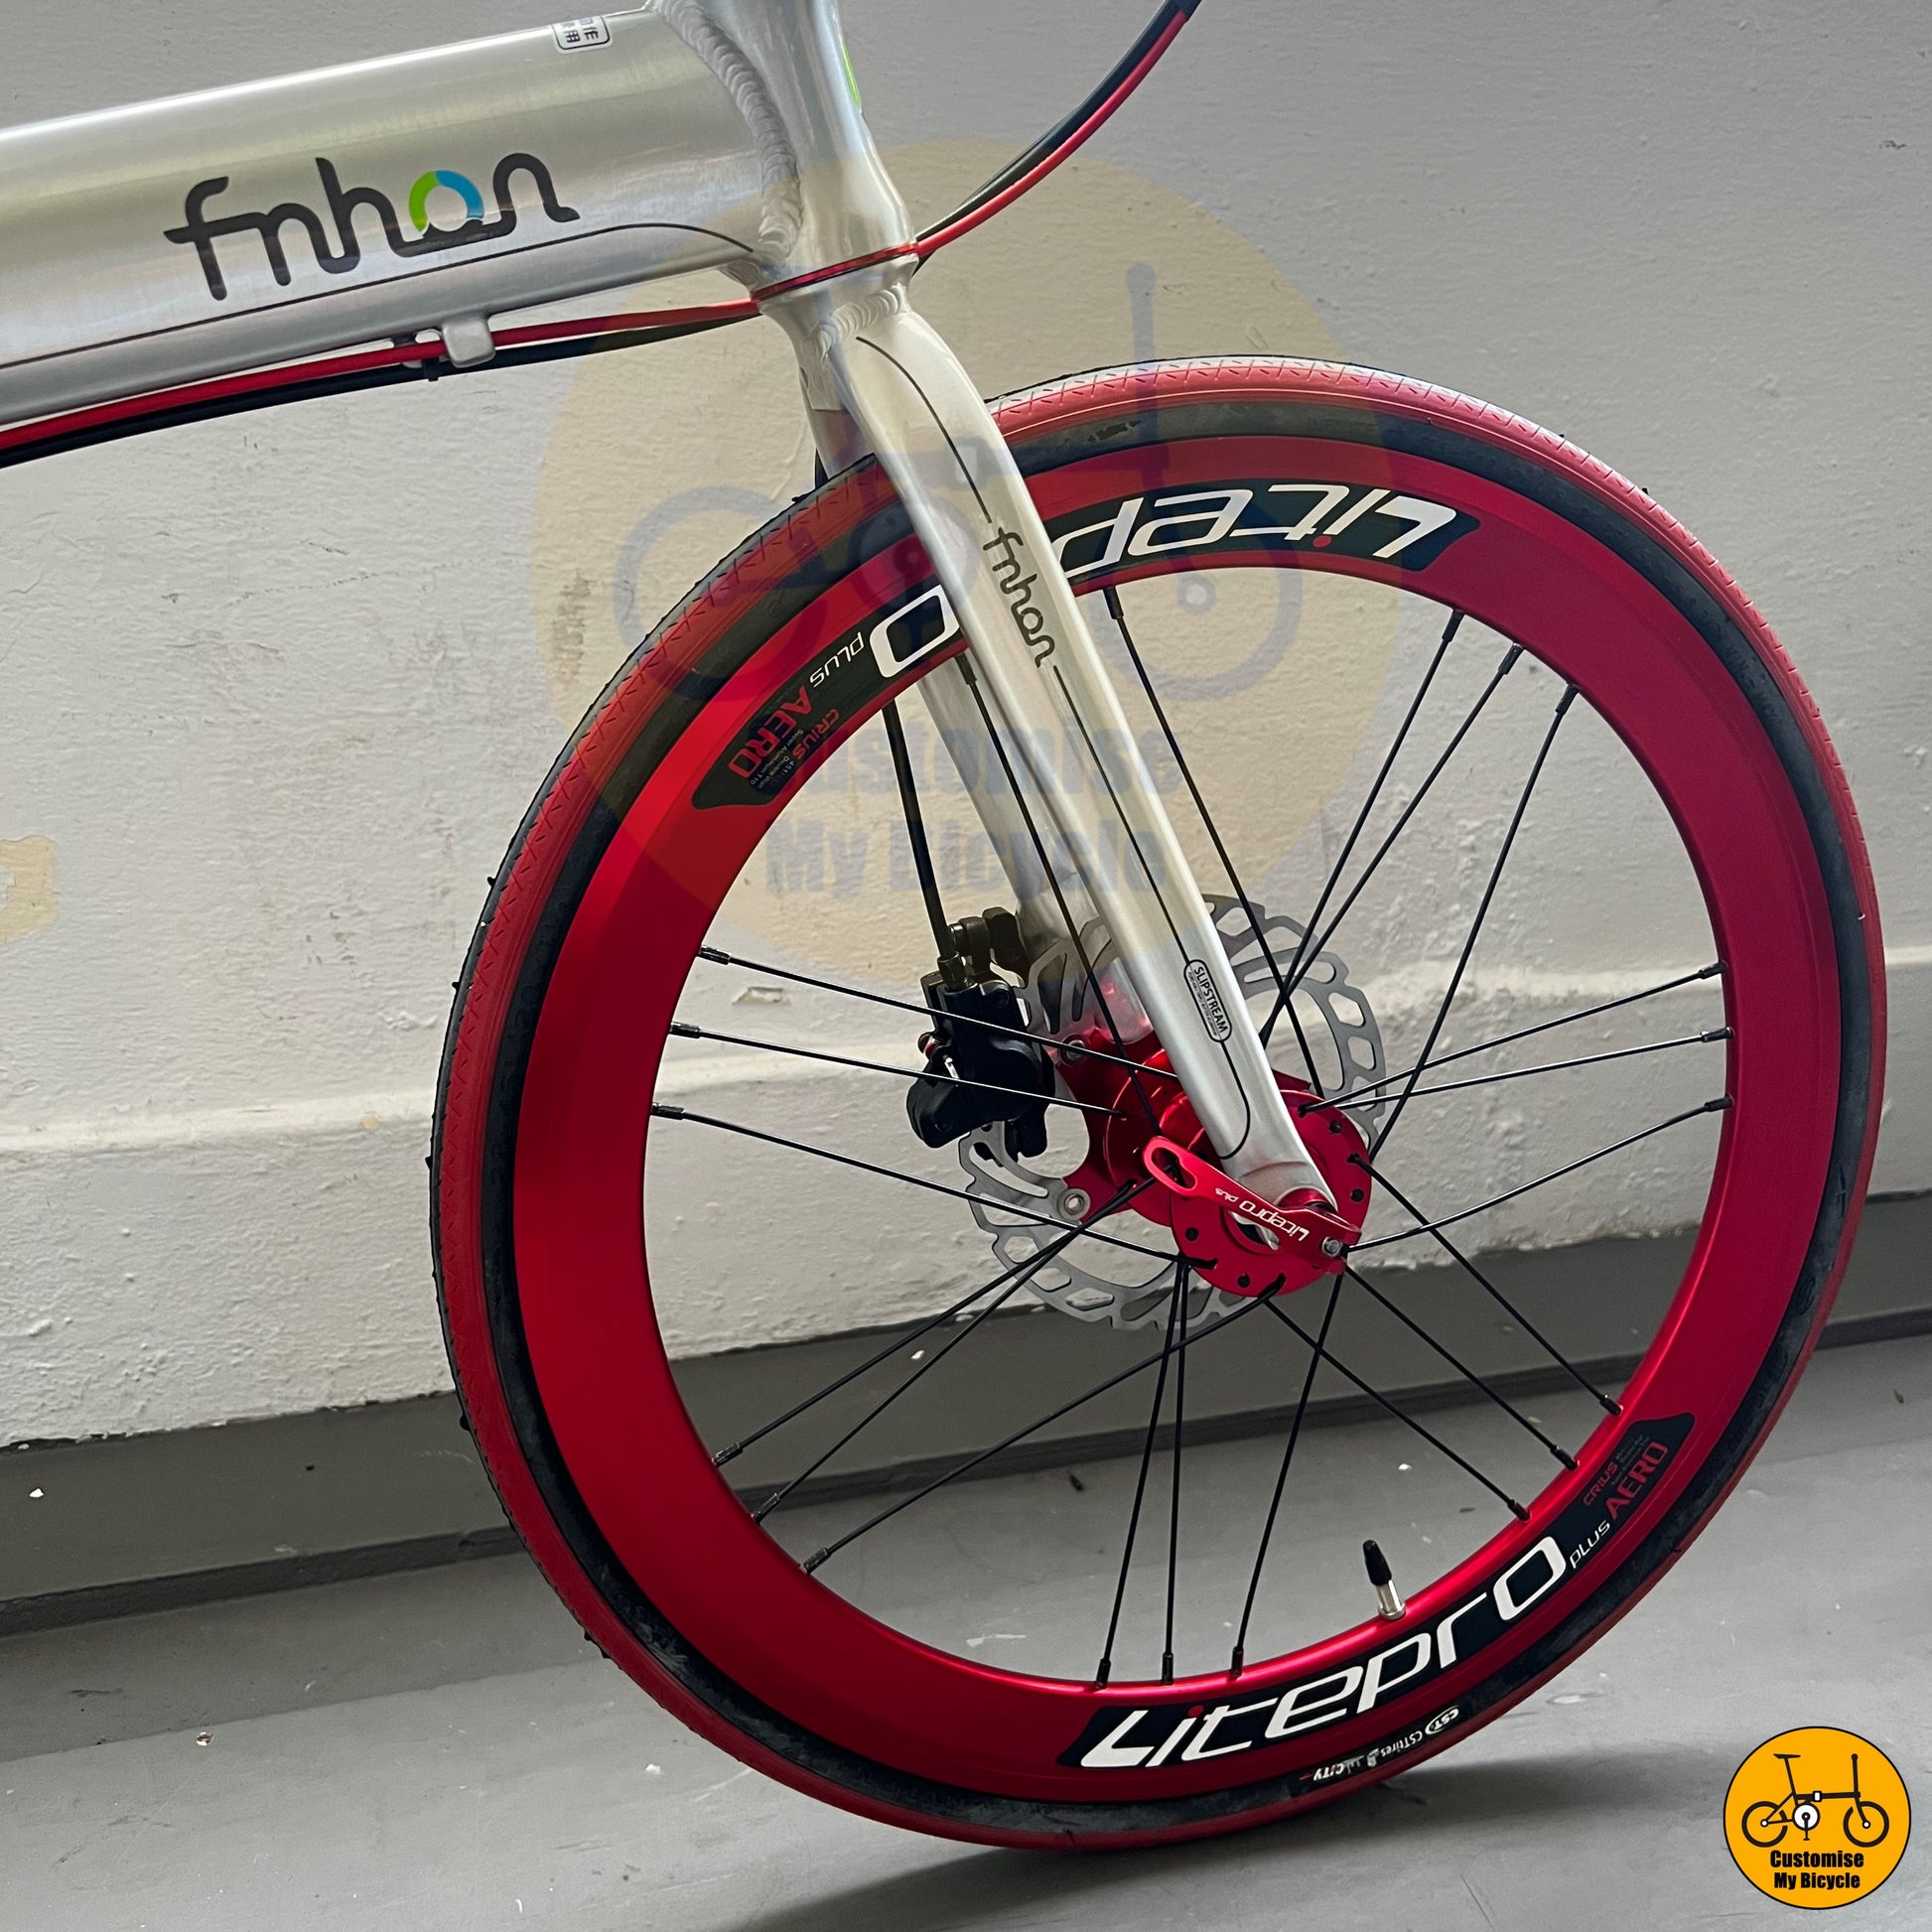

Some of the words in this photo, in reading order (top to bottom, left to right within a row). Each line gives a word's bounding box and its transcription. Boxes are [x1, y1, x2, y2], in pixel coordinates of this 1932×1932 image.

[728, 685, 813, 778] AERO
[791, 708, 841, 761] CRIUS
[1193, 966, 1229, 1035] SLIPSTREAM
[1583, 1461, 1619, 1506] CRIUS
[1605, 1442, 1669, 1520] AERO
[1380, 1729, 1424, 1757] CSTtires
